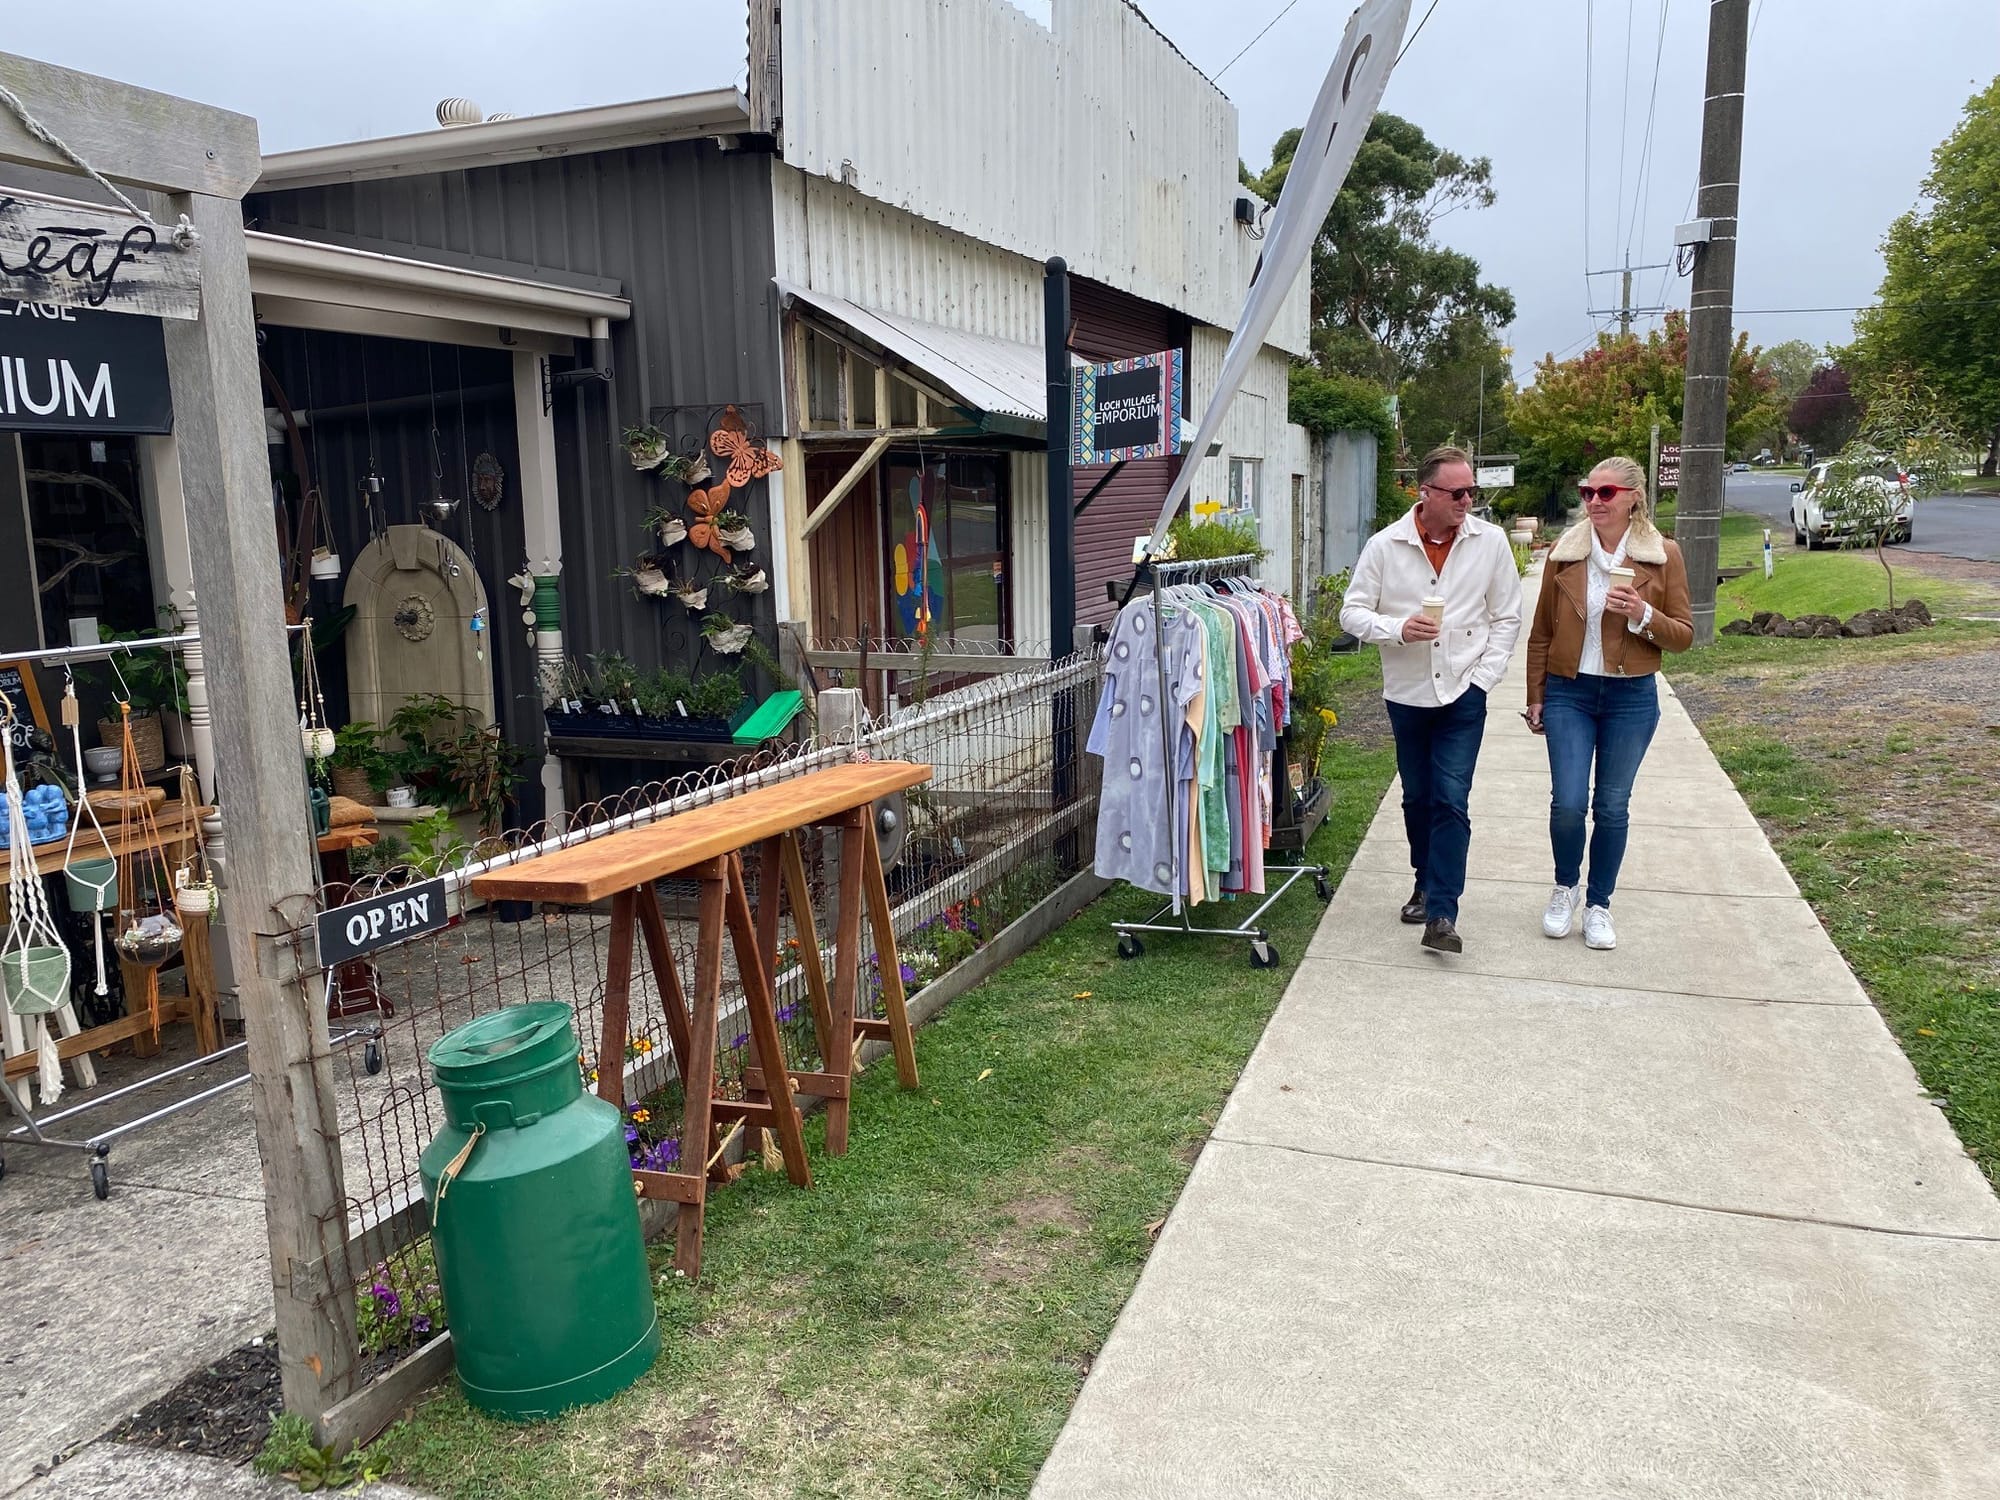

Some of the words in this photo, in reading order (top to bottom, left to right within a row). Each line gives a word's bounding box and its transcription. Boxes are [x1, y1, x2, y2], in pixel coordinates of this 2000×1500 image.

[0, 300, 76, 322] AGE
[0, 356, 116, 418] IUM
[1094, 403, 1161, 425] EMPORIUM
[1099, 400, 1121, 412] LOCH
[1122, 394, 1156, 408] VILLAGE
[345, 892, 430, 946] OPEN
